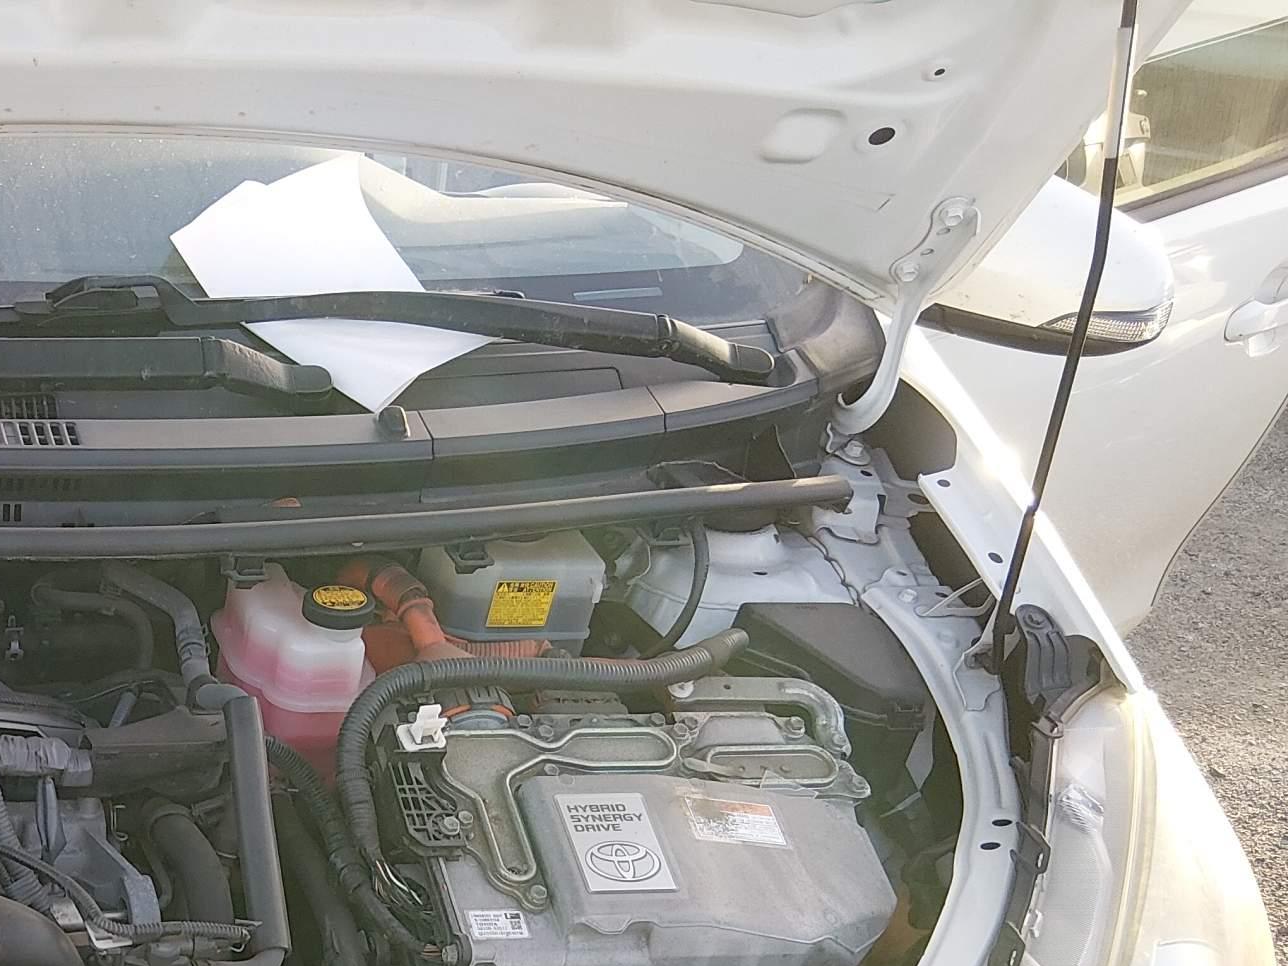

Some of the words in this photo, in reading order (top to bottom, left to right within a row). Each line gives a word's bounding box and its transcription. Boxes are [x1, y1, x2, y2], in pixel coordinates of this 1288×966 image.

[567, 803, 626, 813] HYBRID
[570, 813, 643, 823] SYNERGY
[573, 823, 623, 833] DRIVE
